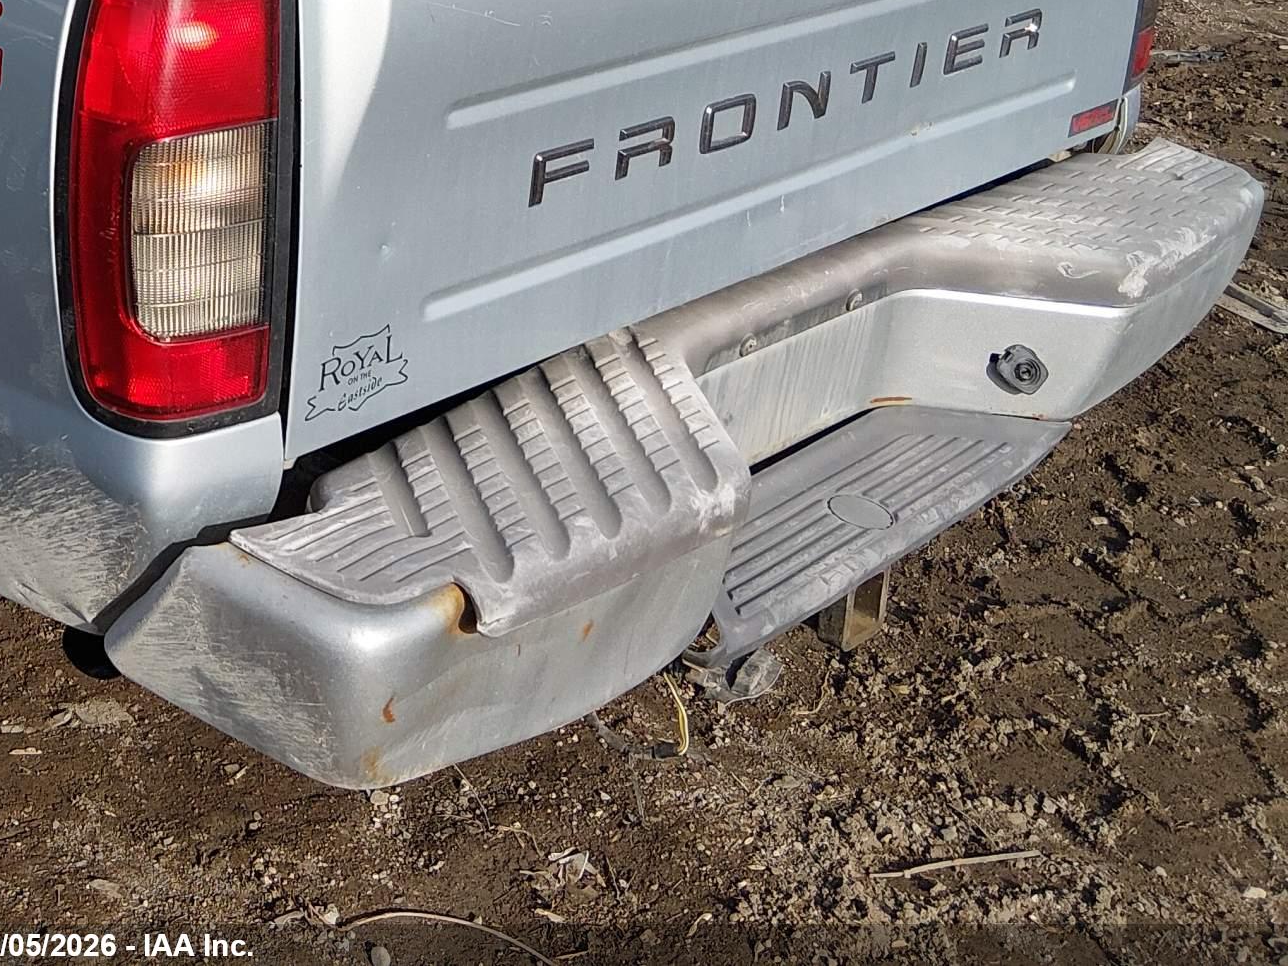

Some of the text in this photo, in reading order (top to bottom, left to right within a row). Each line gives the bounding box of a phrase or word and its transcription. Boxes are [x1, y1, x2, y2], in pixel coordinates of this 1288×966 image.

[527, 7, 1044, 208] FRONTIER
[319, 335, 403, 392] ROYAL
[347, 370, 372, 386] ON THE
